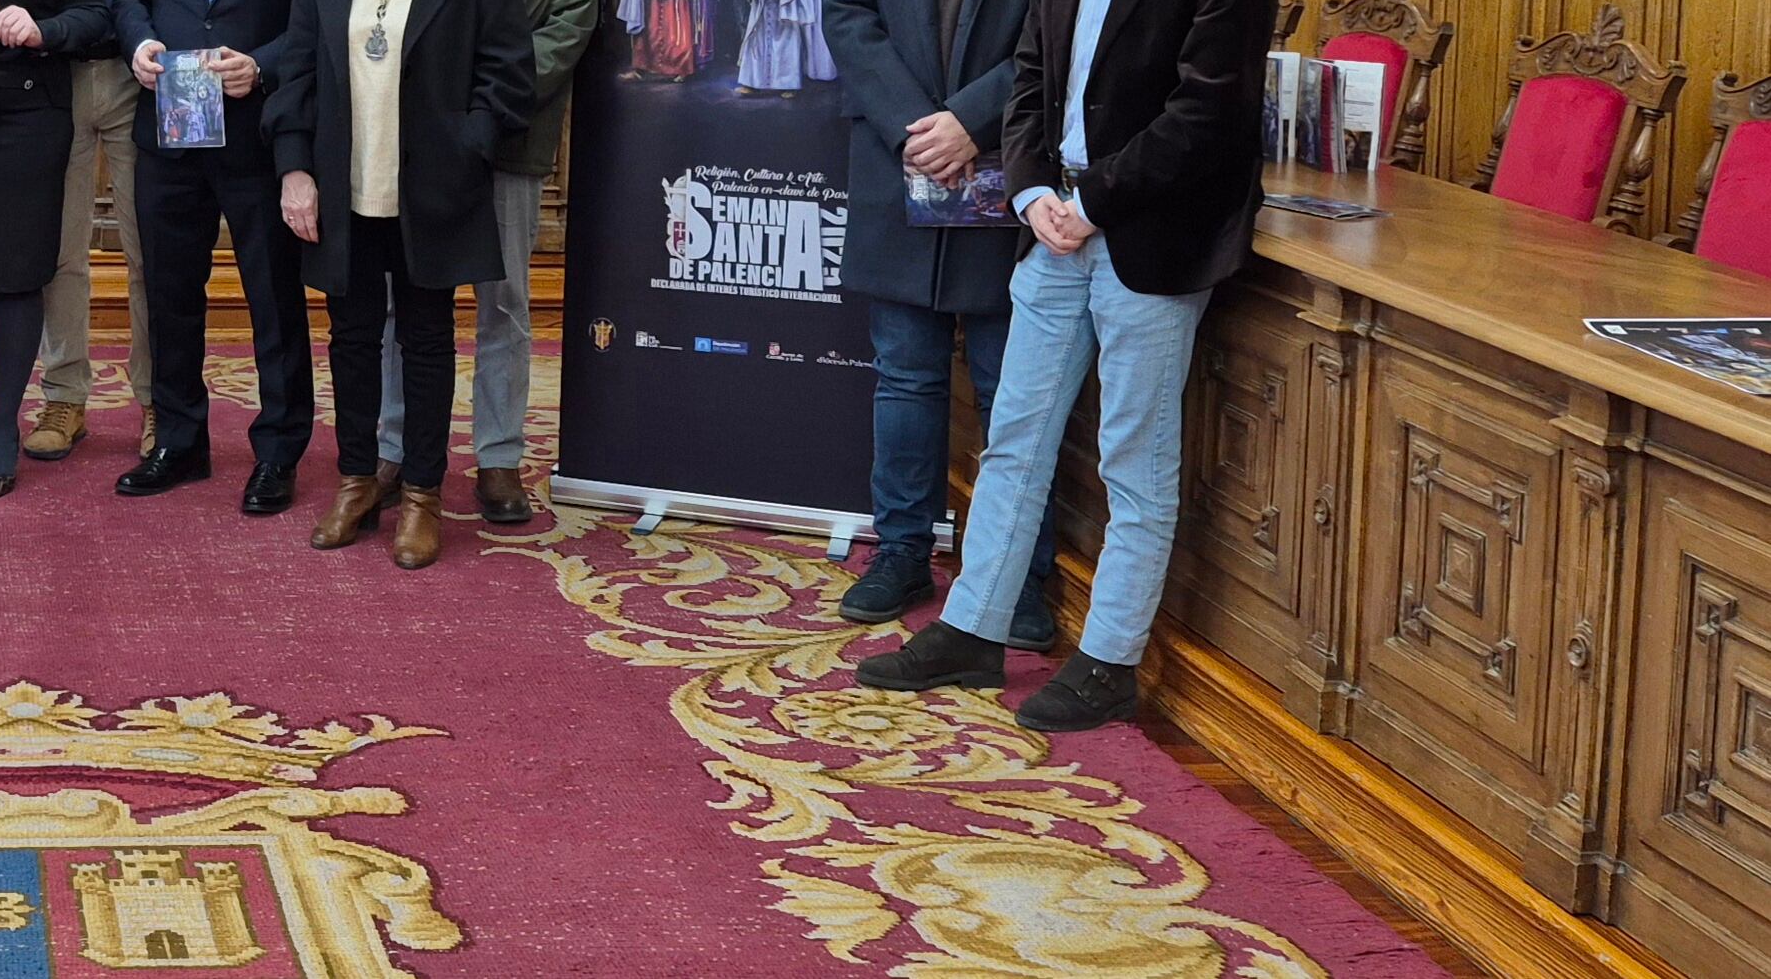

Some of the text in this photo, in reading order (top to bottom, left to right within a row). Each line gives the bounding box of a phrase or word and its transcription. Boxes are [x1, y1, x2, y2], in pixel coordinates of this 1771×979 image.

[744, 168, 784, 182] Cultura
[711, 180, 759, 194] Palencia
[806, 186, 820, 197] de
[669, 257, 695, 280] DE
[650, 278, 696, 291] DECLARADA
[696, 282, 707, 292] DE
